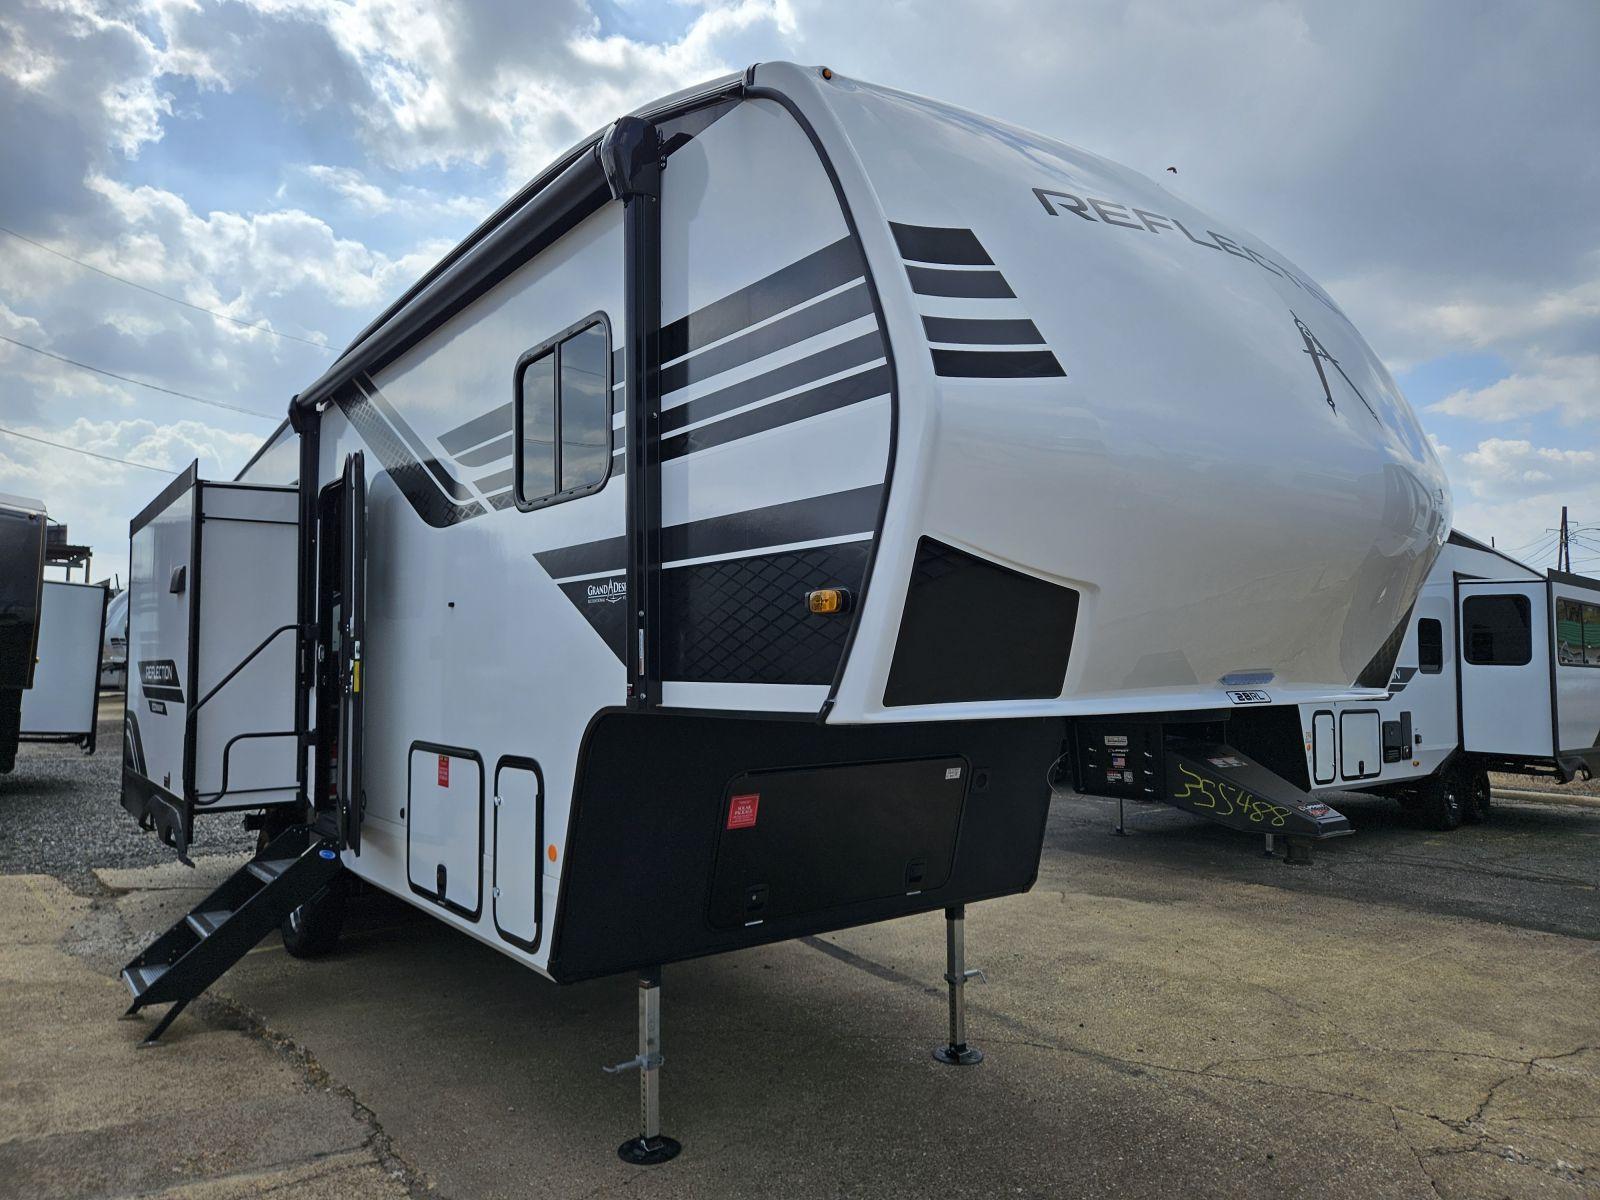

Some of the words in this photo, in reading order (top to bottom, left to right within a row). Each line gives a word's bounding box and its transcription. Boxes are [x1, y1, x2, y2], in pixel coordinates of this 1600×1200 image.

[587, 584, 608, 596] GRAND
[613, 581, 627, 593] DESI
[145, 665, 173, 680] REFLECTION
[1235, 692, 1266, 702] 28RL
